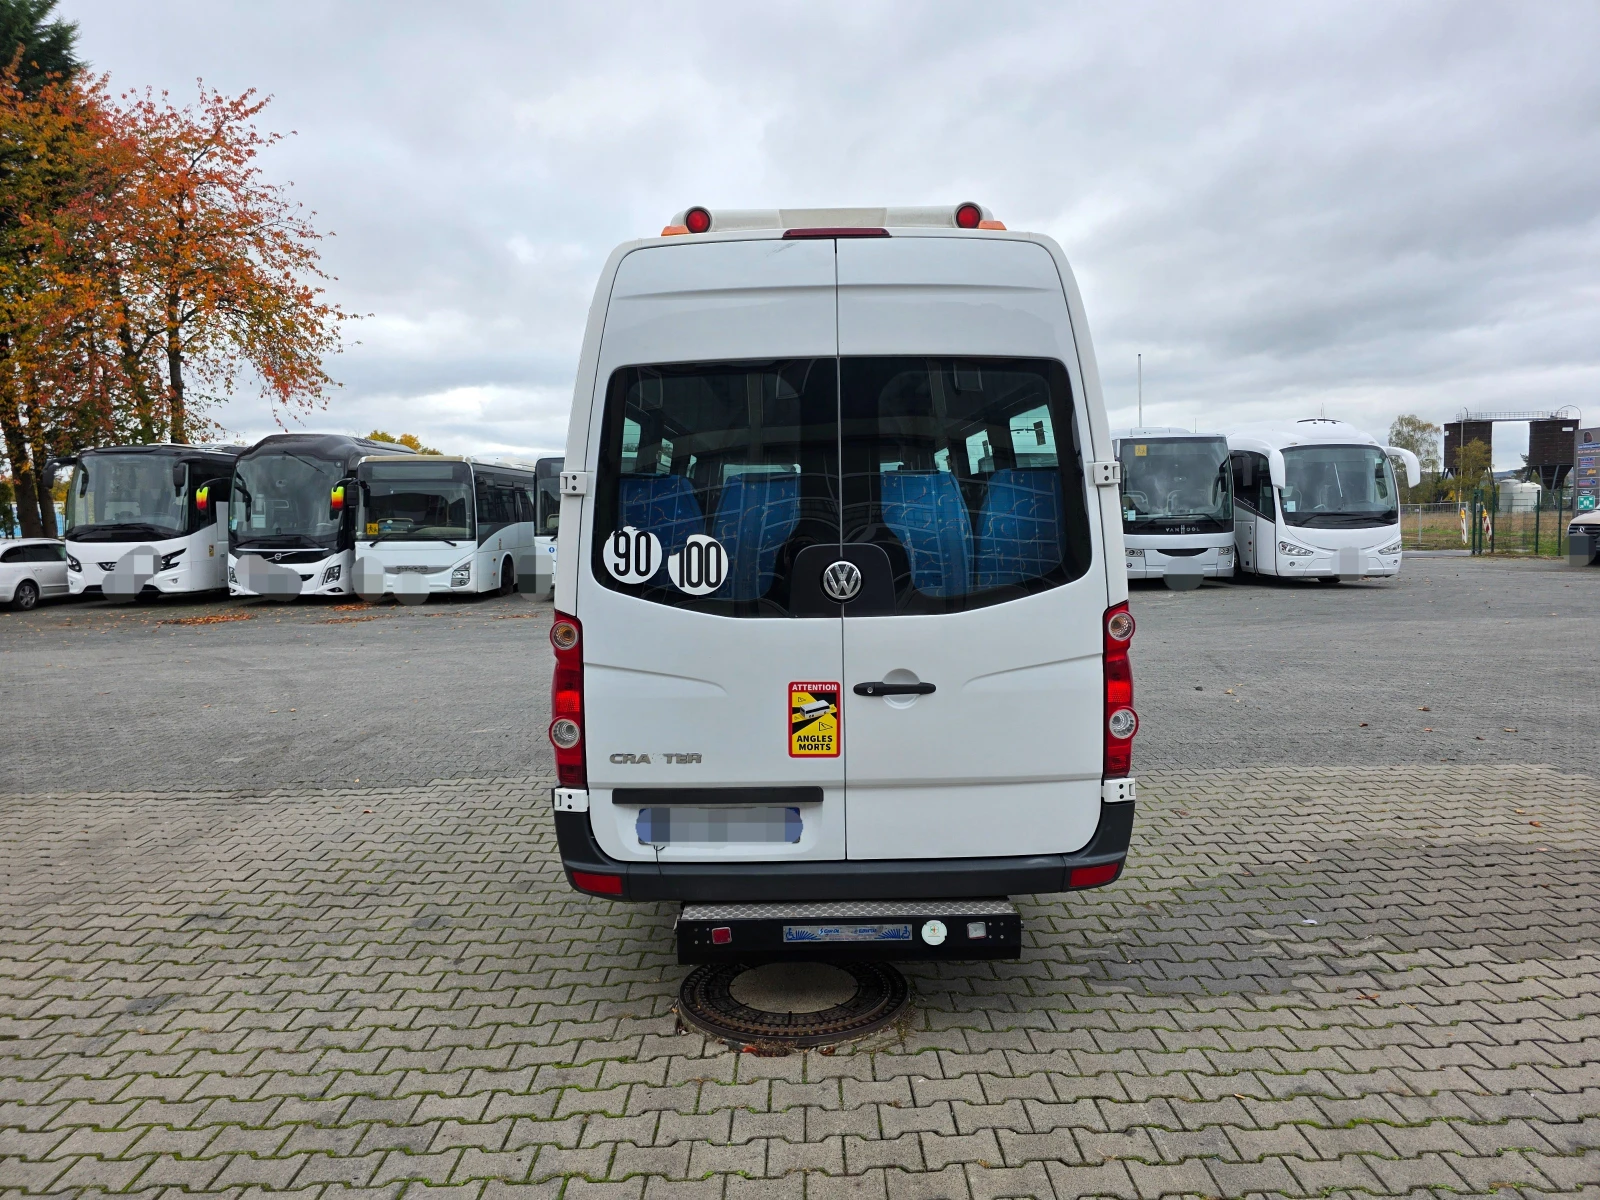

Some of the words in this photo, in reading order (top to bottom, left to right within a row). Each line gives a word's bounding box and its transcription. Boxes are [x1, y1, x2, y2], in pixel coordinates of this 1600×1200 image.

[613, 531, 652, 577] 90
[678, 541, 722, 588] 100
[609, 752, 702, 764] CRATER
[798, 743, 831, 751] MORTS
